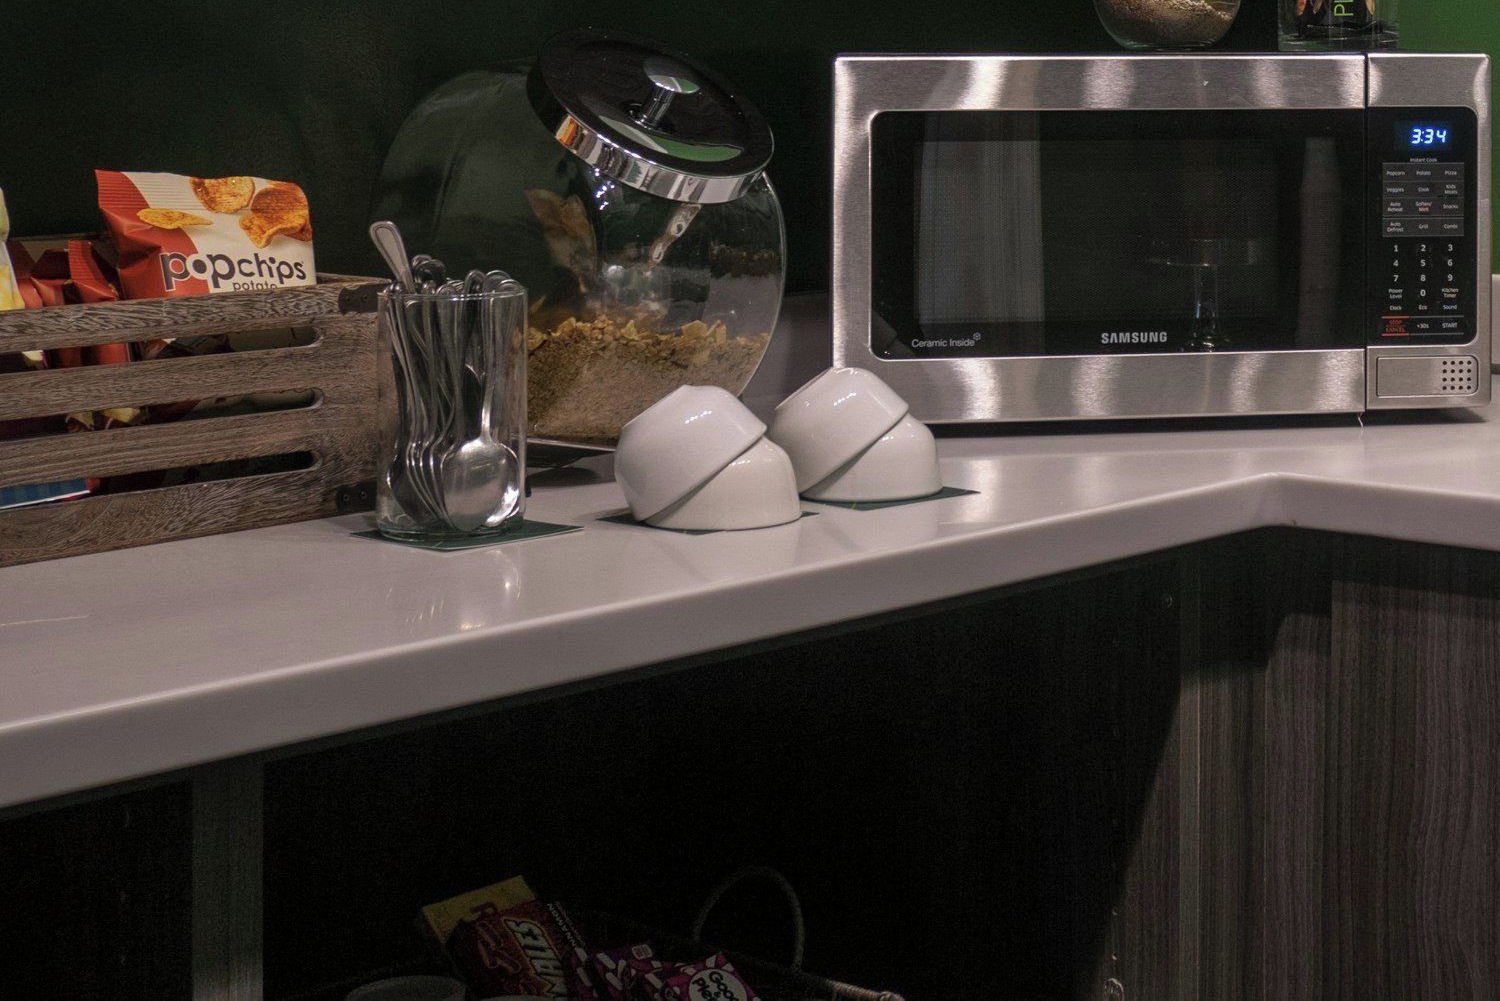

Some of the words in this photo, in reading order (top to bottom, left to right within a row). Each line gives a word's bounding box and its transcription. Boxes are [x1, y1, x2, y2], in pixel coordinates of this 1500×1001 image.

[1412, 129, 1447, 144] 3:34
[159, 252, 306, 292] popchips
[911, 339, 948, 347] Ceramic
[949, 338, 975, 347] Inside
[1101, 331, 1168, 344] SAMSUNG
